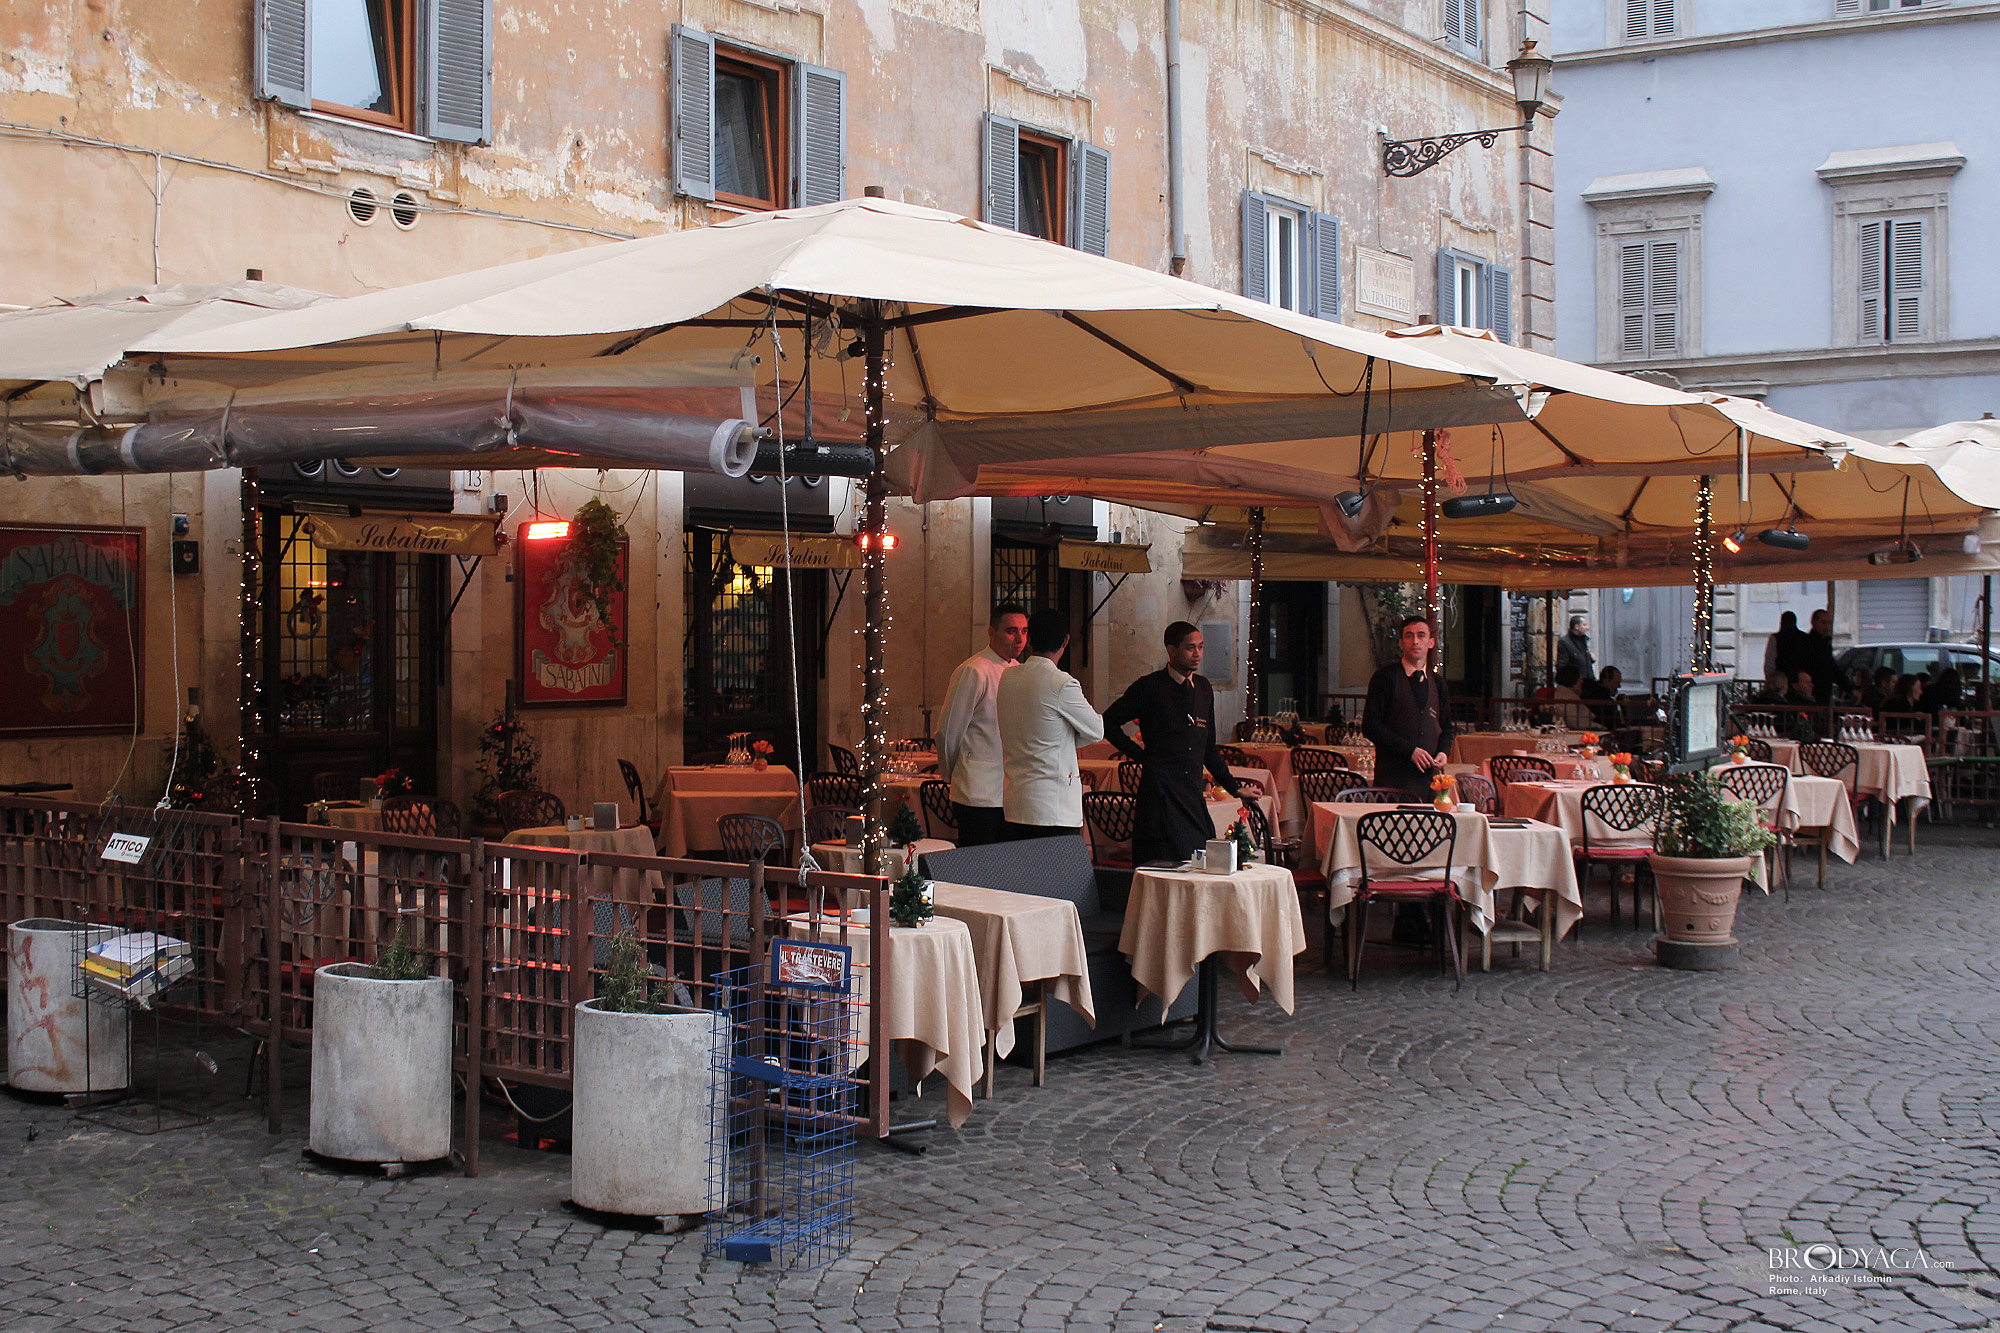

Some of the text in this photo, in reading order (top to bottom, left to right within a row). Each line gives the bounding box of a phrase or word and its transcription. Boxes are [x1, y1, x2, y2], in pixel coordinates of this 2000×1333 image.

[1375, 263, 1397, 281] PIAZZA
[1370, 290, 1410, 312] TRASTEVERE
[467, 470, 482, 487] 13
[356, 523, 451, 550] Sabatini
[16, 537, 120, 582] SABATINI
[764, 544, 830, 565] Sabatini
[1081, 551, 1123, 570] Sabatini
[545, 664, 605, 692] SABATINI
[107, 839, 143, 852] ATTICO
